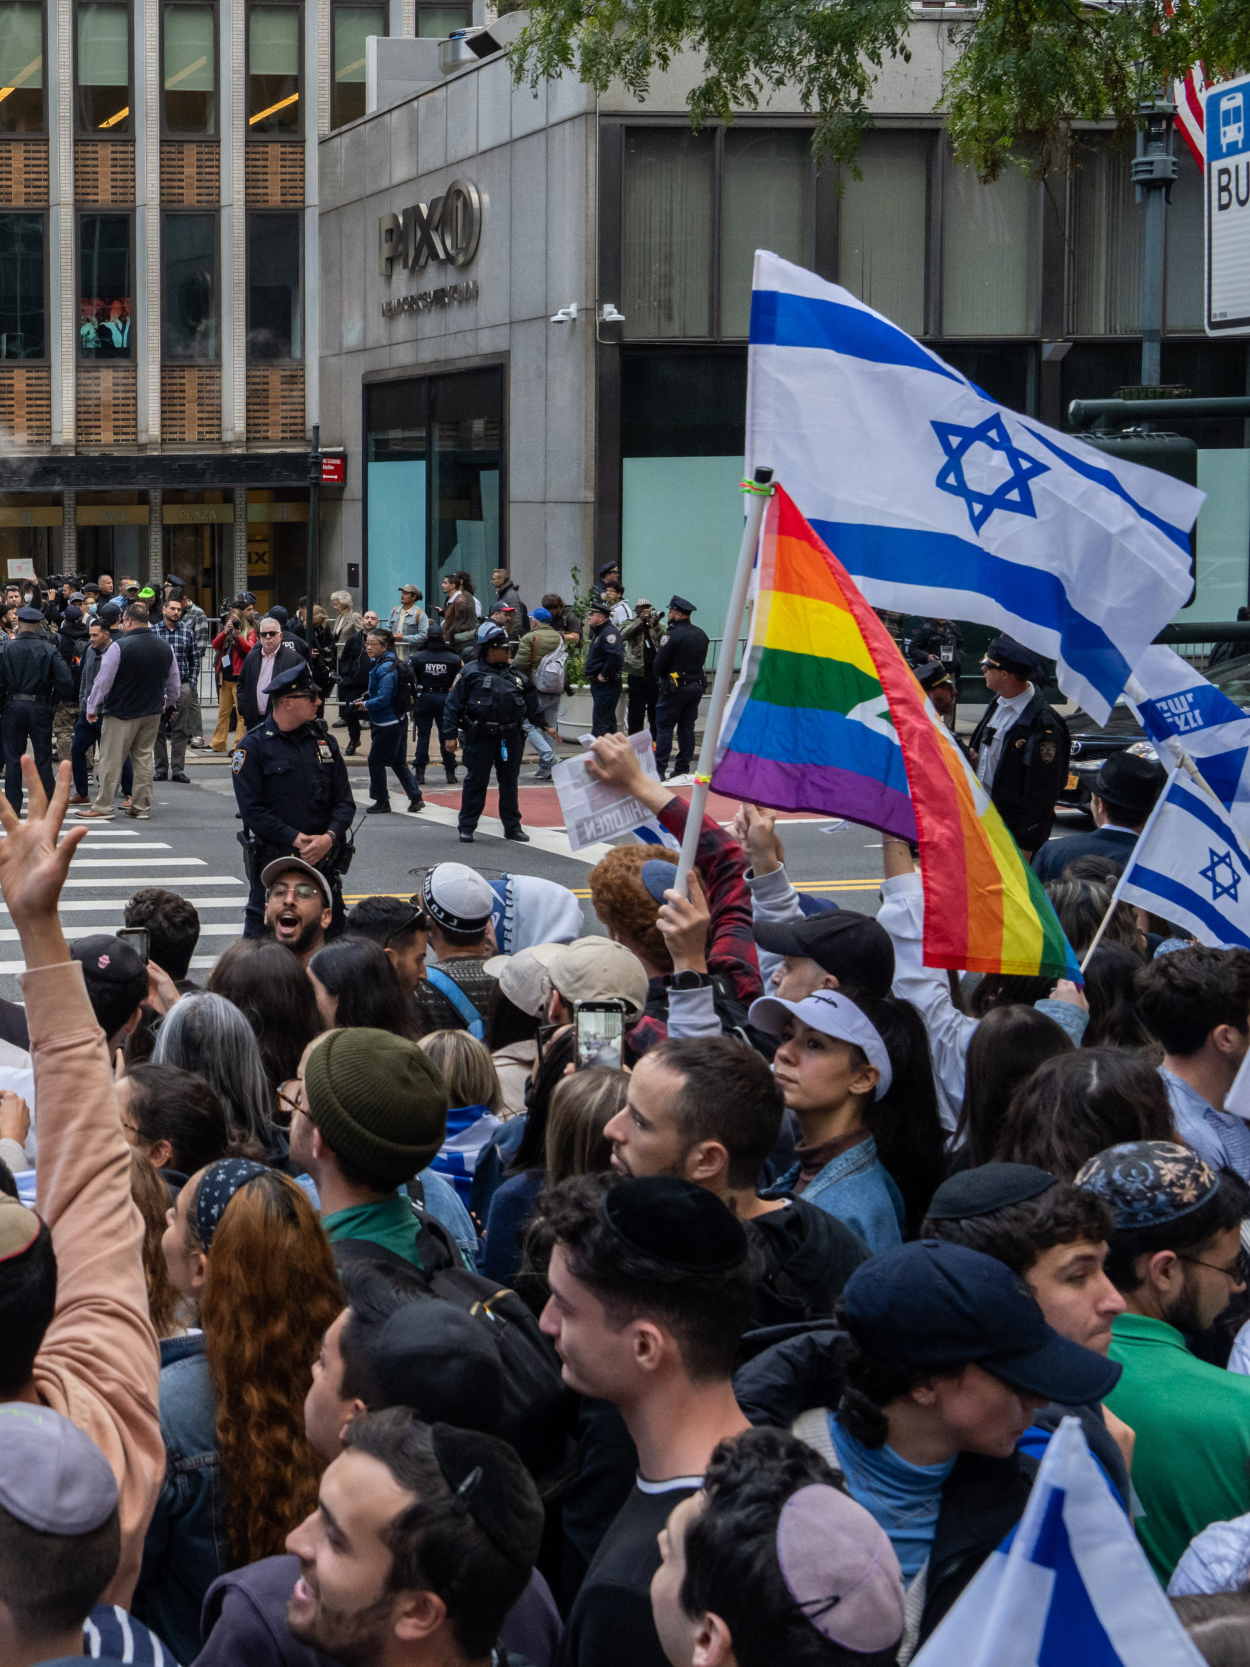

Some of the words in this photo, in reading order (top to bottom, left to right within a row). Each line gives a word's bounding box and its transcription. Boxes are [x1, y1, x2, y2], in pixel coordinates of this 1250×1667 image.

[1217, 161, 1250, 212] BU
[179, 510, 217, 520] PLAZA
[248, 551, 268, 564] IX
[425, 663, 447, 672] NYPD
